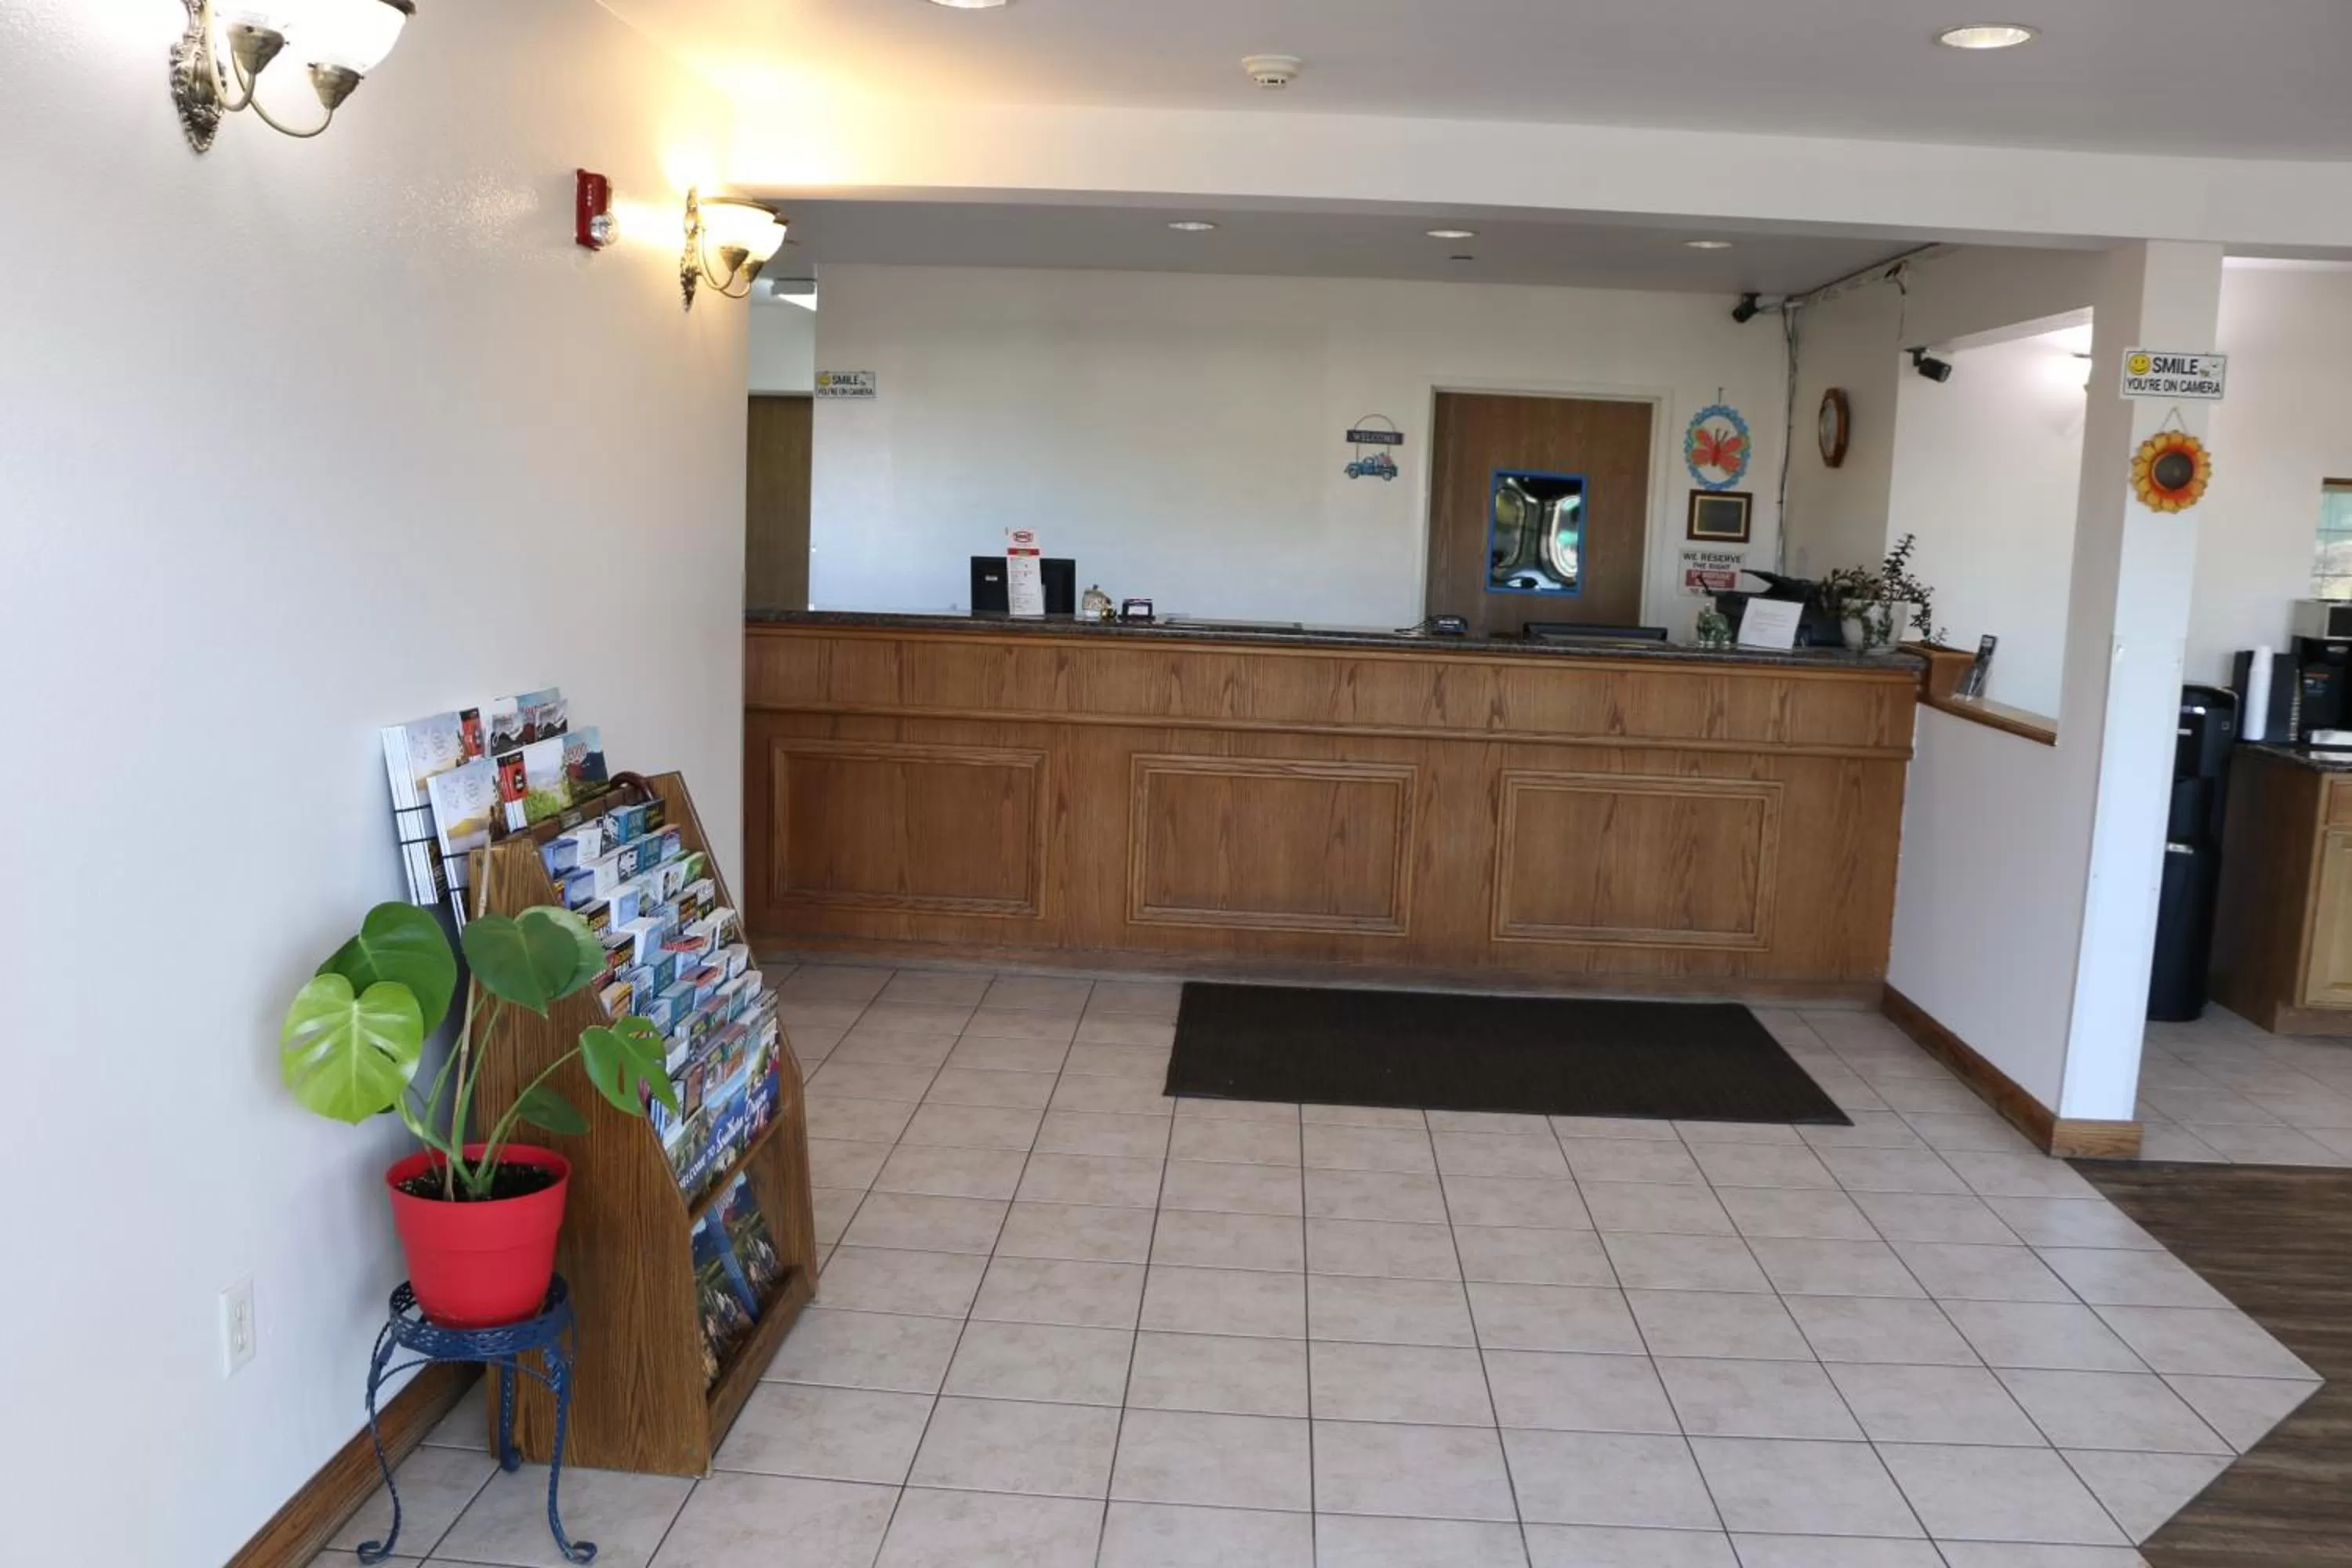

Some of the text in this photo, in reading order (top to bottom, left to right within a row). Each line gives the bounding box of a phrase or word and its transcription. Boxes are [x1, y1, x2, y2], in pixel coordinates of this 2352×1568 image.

[2152, 357, 2199, 376] SMILE
[2127, 377, 2221, 394] YOU'RE ON CAMERA
[1700, 553, 1741, 564] RESERVE
